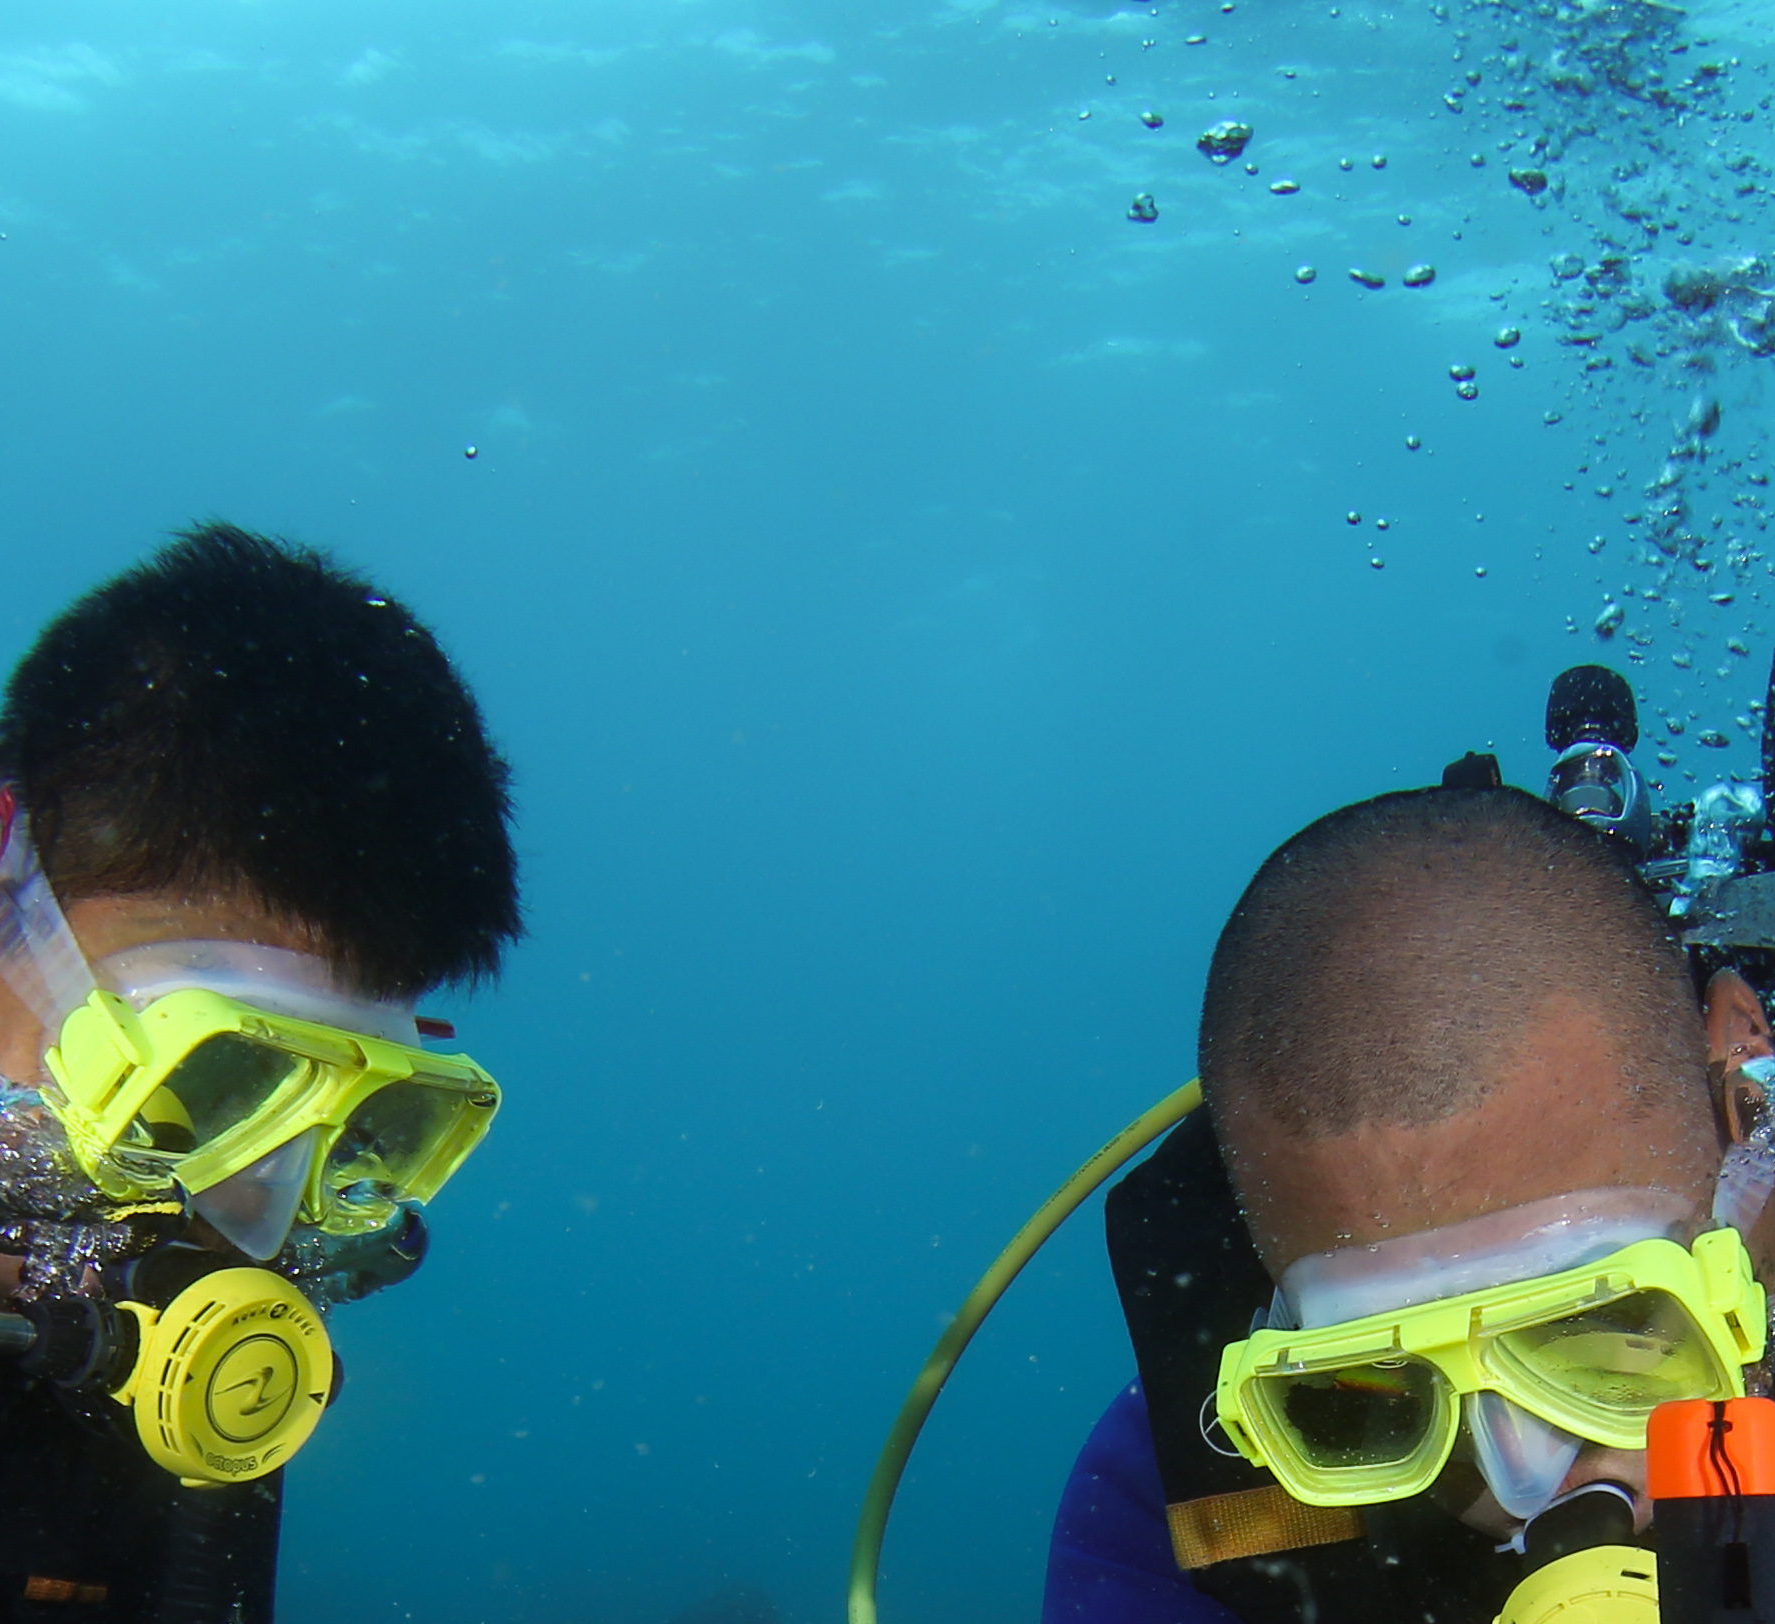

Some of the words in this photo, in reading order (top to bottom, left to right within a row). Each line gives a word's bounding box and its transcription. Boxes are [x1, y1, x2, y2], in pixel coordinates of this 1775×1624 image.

[231, 1304, 267, 1326] AQUA
[286, 1306, 316, 1337] LUNG
[206, 1451, 258, 1478] octopus
